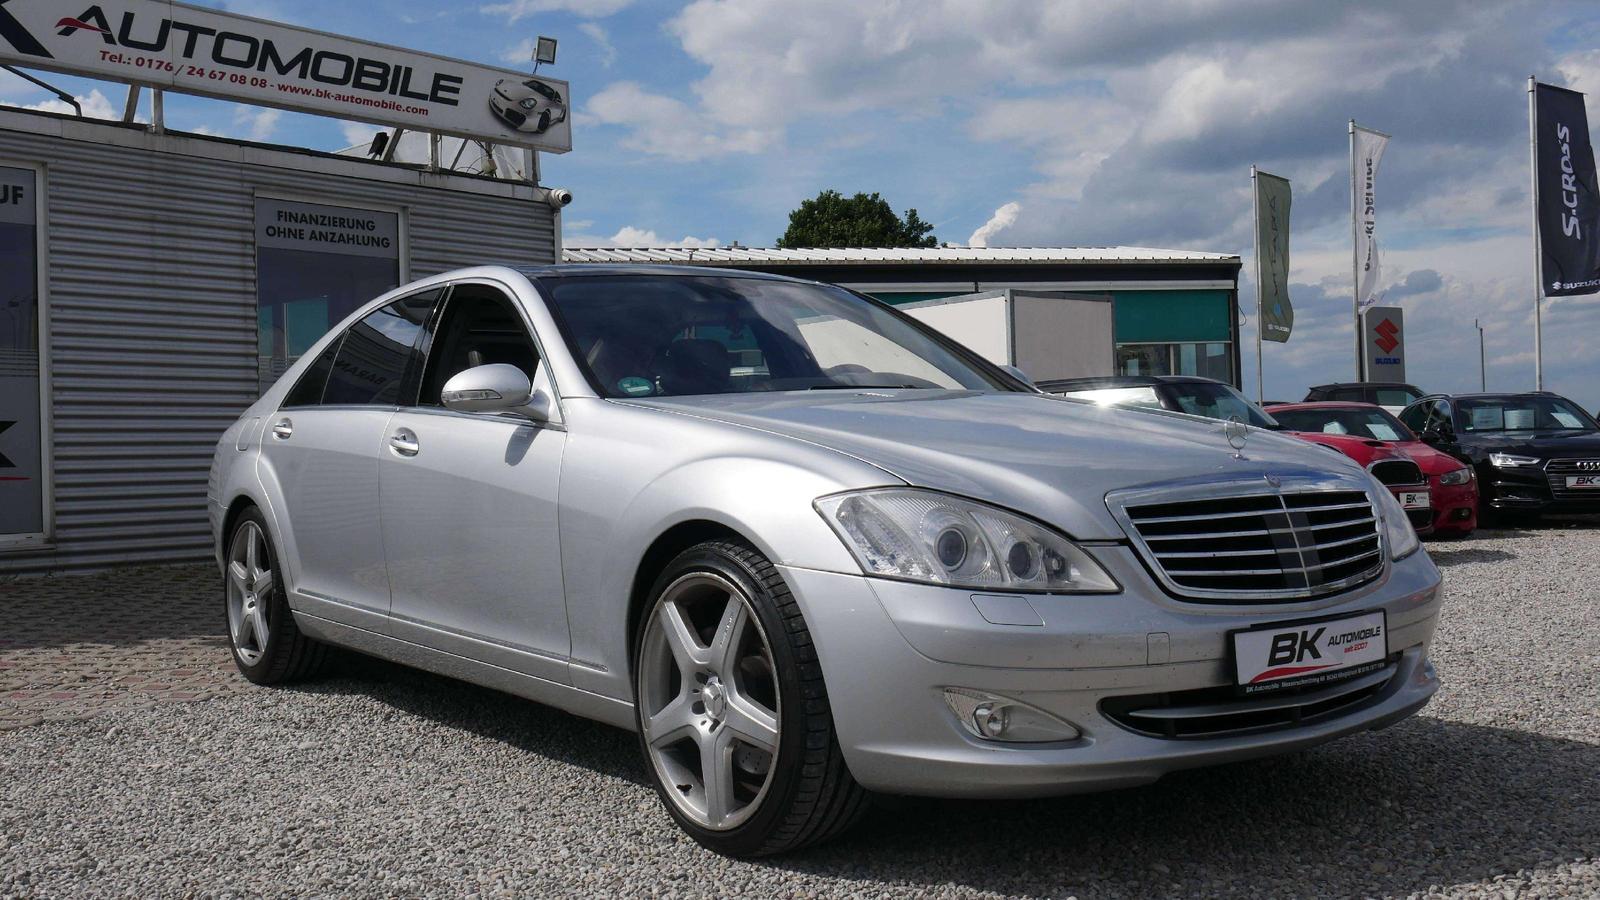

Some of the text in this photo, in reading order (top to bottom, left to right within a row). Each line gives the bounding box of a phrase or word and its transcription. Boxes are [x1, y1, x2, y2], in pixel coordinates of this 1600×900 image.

[55, 5, 464, 106] AUTOMOBILE
[100, 50, 131, 66] Tel.:
[135, 56, 174, 73] 0176
[186, 65, 205, 79] 24
[208, 69, 227, 82] 67
[229, 73, 248, 86] 08
[250, 76, 268, 89] 08
[277, 82, 430, 116] www.bk-automobile.com
[265, 225, 391, 249] OHNE ANZAHLUNG
[277, 209, 376, 232] FINANZIERUNG
[1268, 626, 1381, 667] BK AUTOMOBILE
